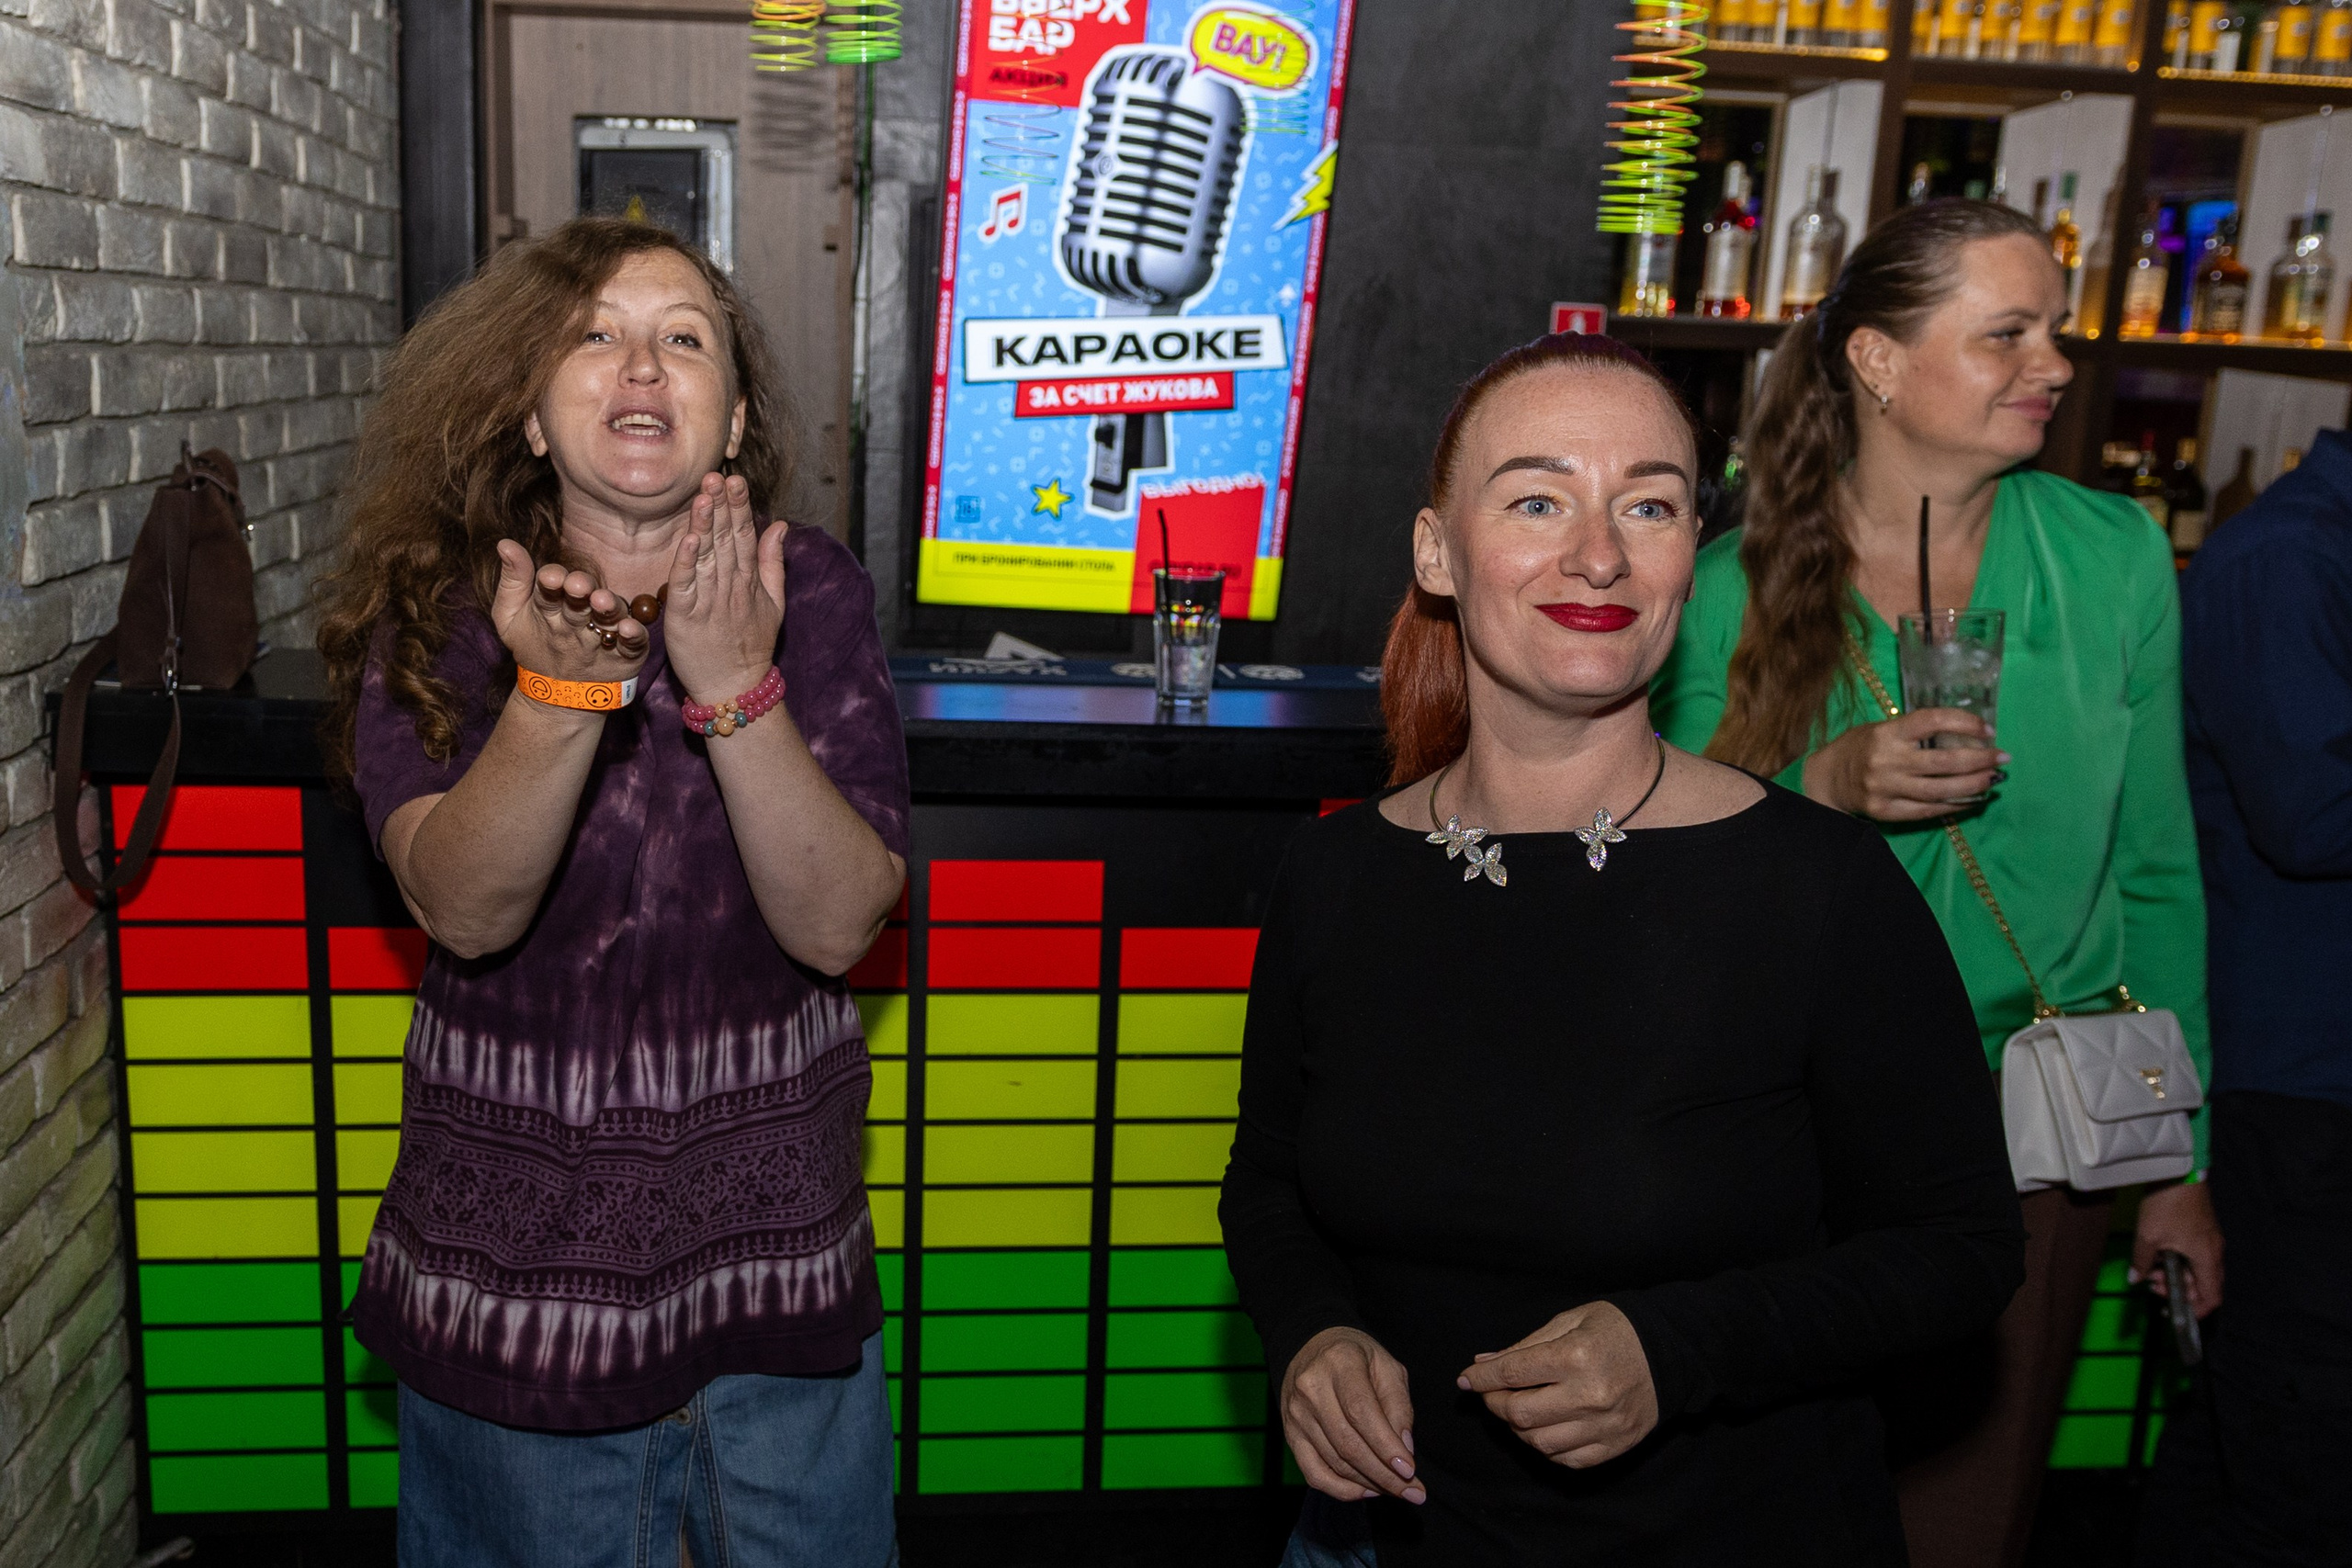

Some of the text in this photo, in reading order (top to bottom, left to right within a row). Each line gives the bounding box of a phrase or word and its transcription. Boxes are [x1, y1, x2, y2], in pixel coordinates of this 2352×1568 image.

[989, 16, 1075, 55] БАР
[1209, 21, 1287, 72] ВАУ!
[995, 328, 1261, 367] КАРАОКЕ
[1029, 377, 1219, 408] ЗА СЧЕТ ЖУКОВА
